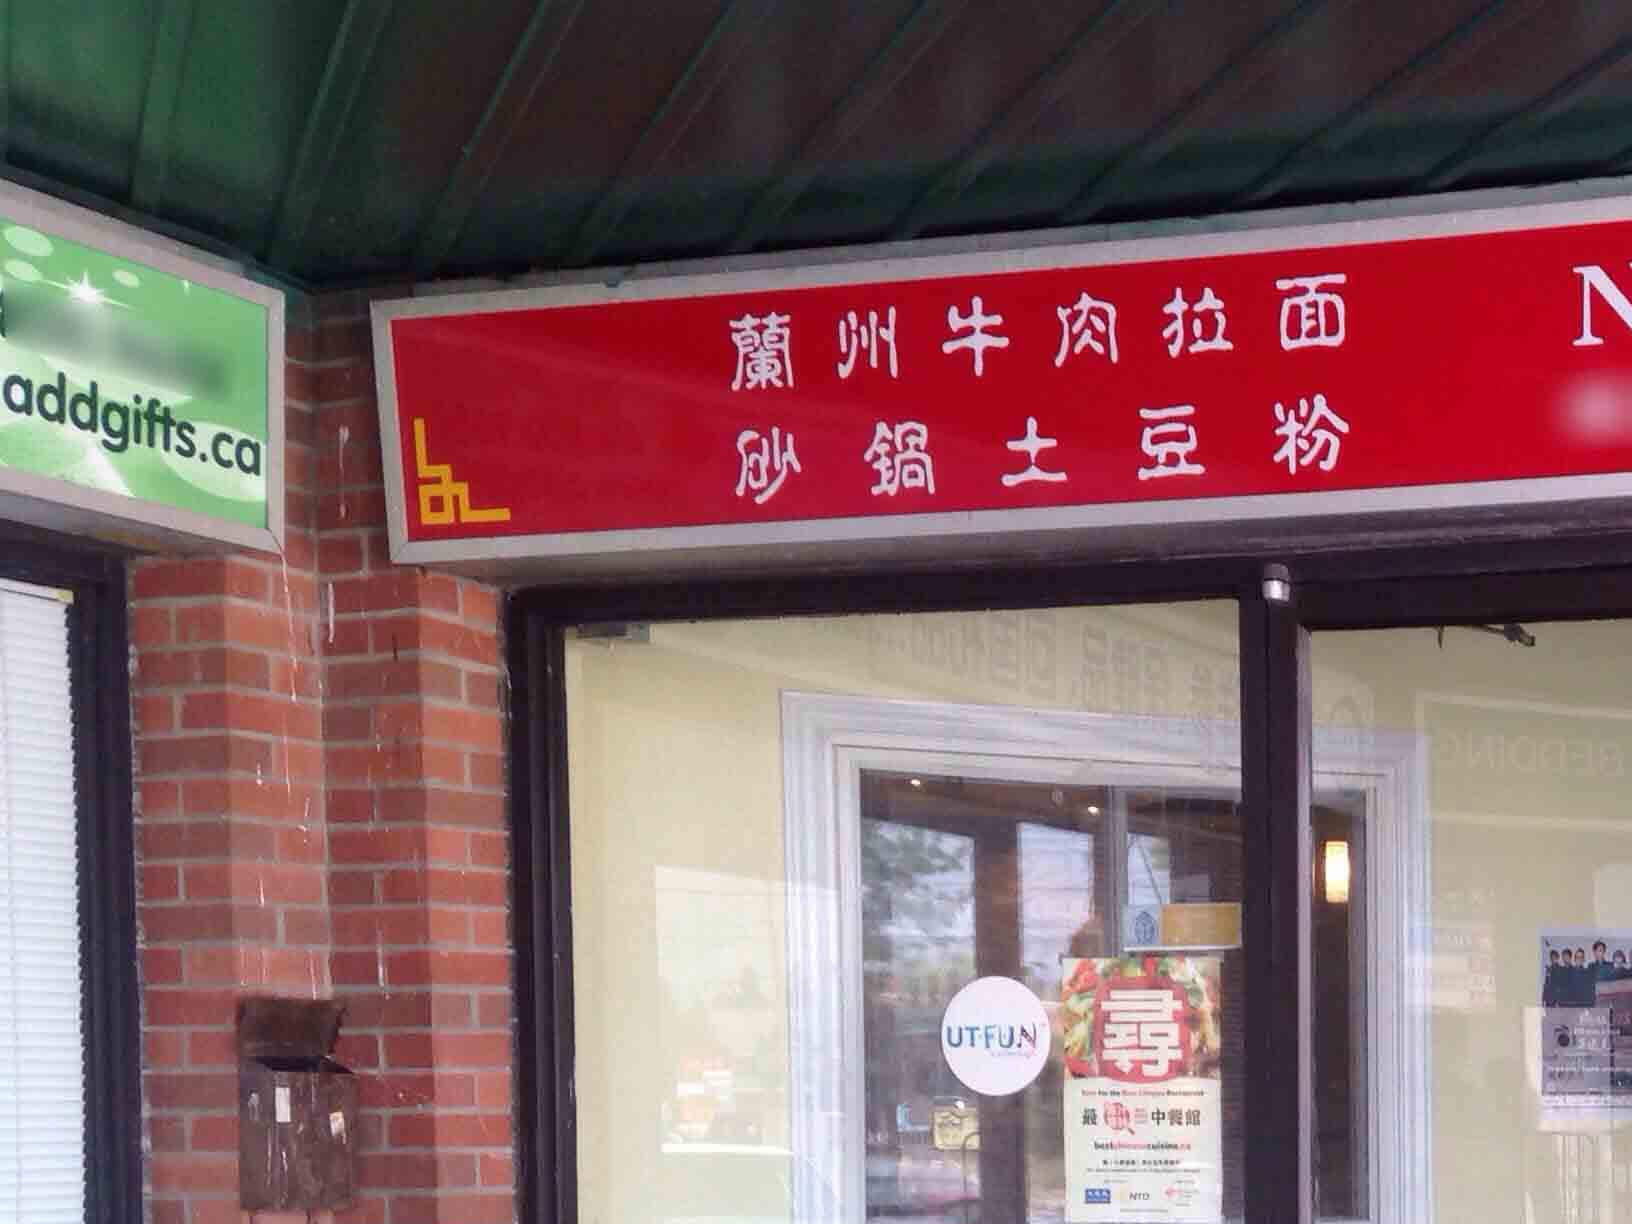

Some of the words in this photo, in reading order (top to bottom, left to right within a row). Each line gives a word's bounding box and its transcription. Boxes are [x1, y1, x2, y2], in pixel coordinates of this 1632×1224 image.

[729, 272, 1348, 391] 蘭州牛肉拉面
[735, 393, 1350, 504] 砂鍋土豆粉
